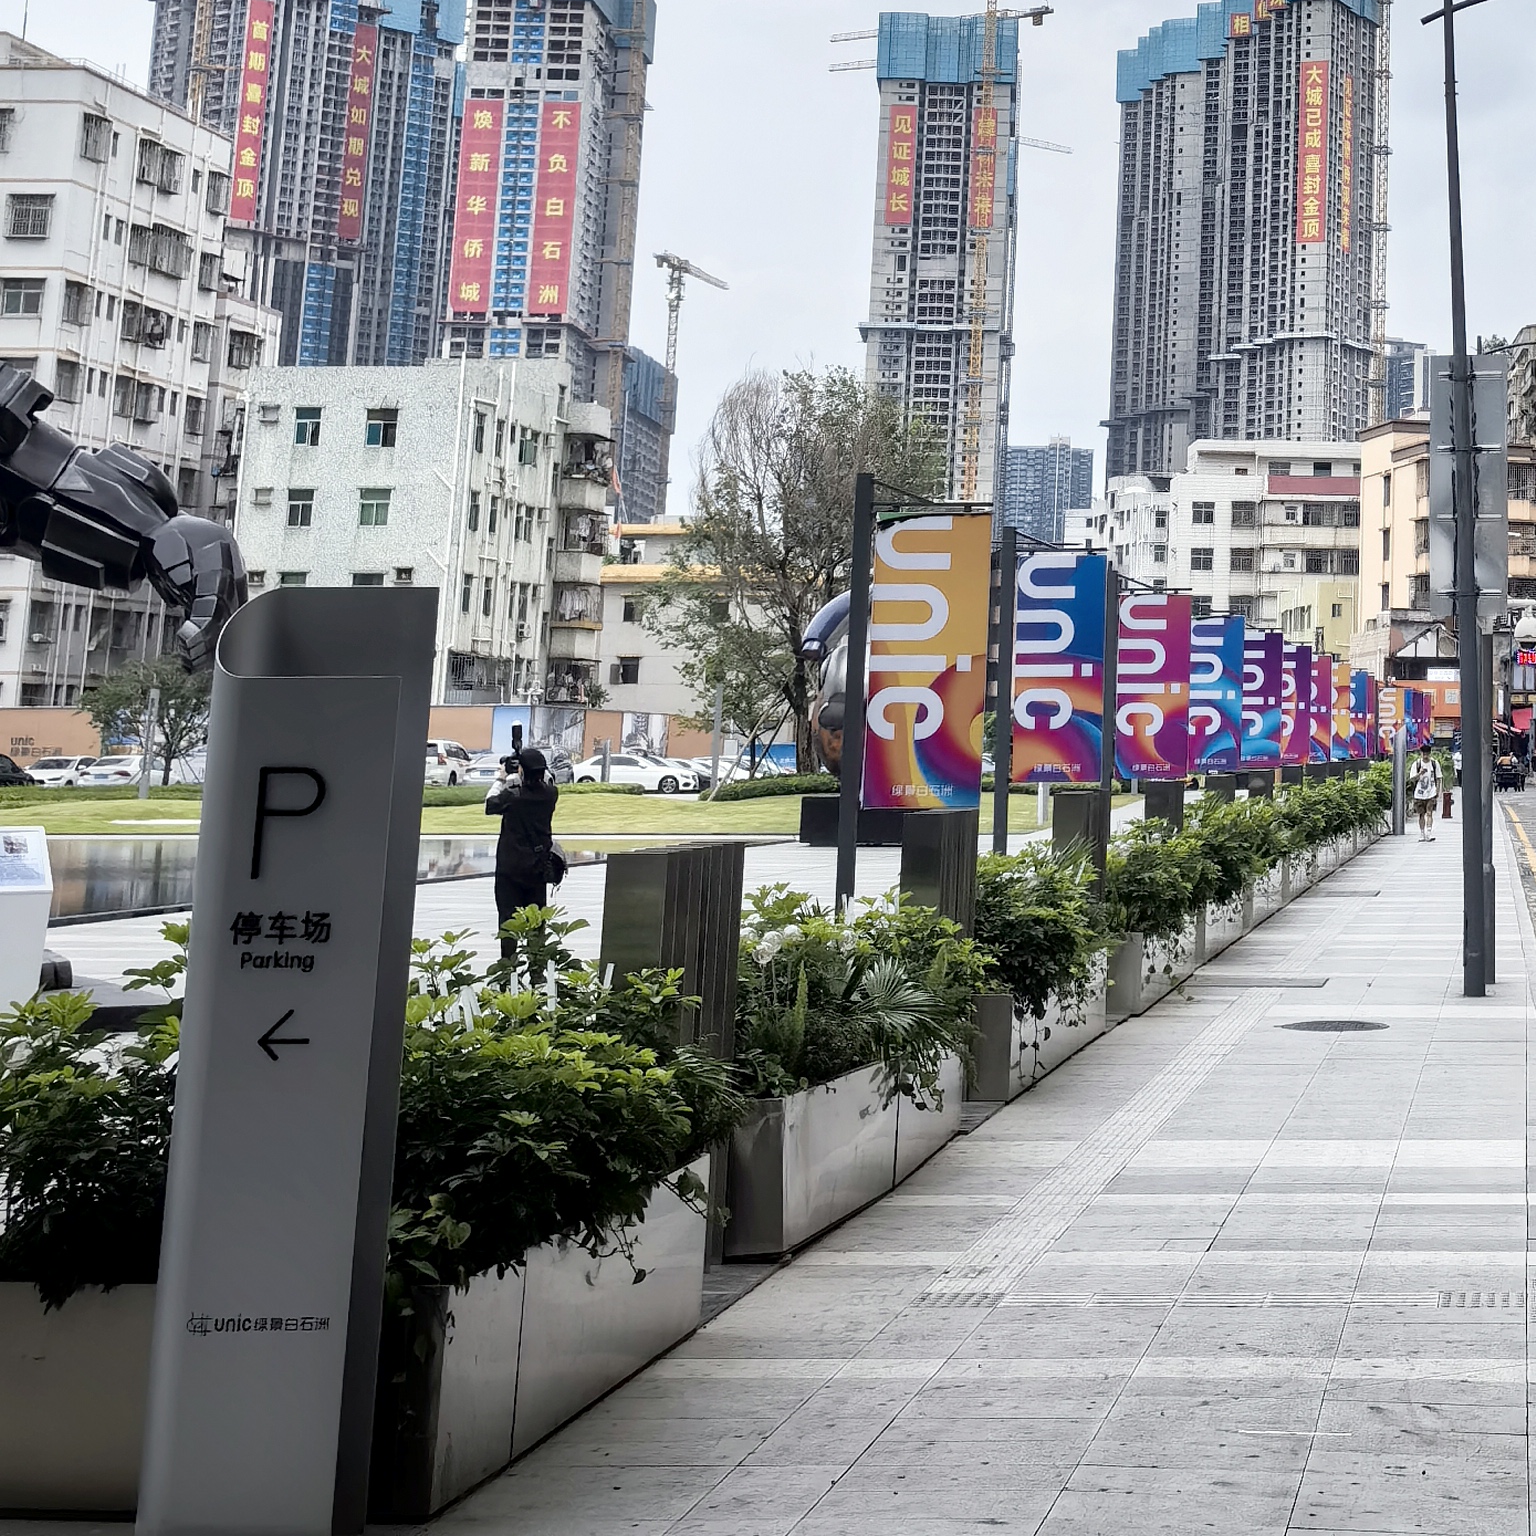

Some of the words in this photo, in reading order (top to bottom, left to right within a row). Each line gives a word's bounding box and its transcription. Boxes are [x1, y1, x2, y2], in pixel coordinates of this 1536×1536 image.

[235, 20, 270, 199] 首期喜封金顶
[342, 47, 372, 218] 大城如期兑现
[890, 114, 912, 212] 见证城长
[460, 109, 493, 303] 焕新华侨城
[538, 109, 572, 305] 不负白石洲
[867, 516, 972, 741] unic
[1013, 555, 1094, 730] unic
[1116, 594, 1181, 737] unic
[1188, 618, 1236, 736] unic
[10, 736, 36, 746] unic
[250, 766, 326, 879] P
[229, 910, 332, 945] 停车场
[240, 950, 315, 973] Parking
[214, 1313, 252, 1332] unic
[254, 1317, 330, 1332] 绿景白石洲
